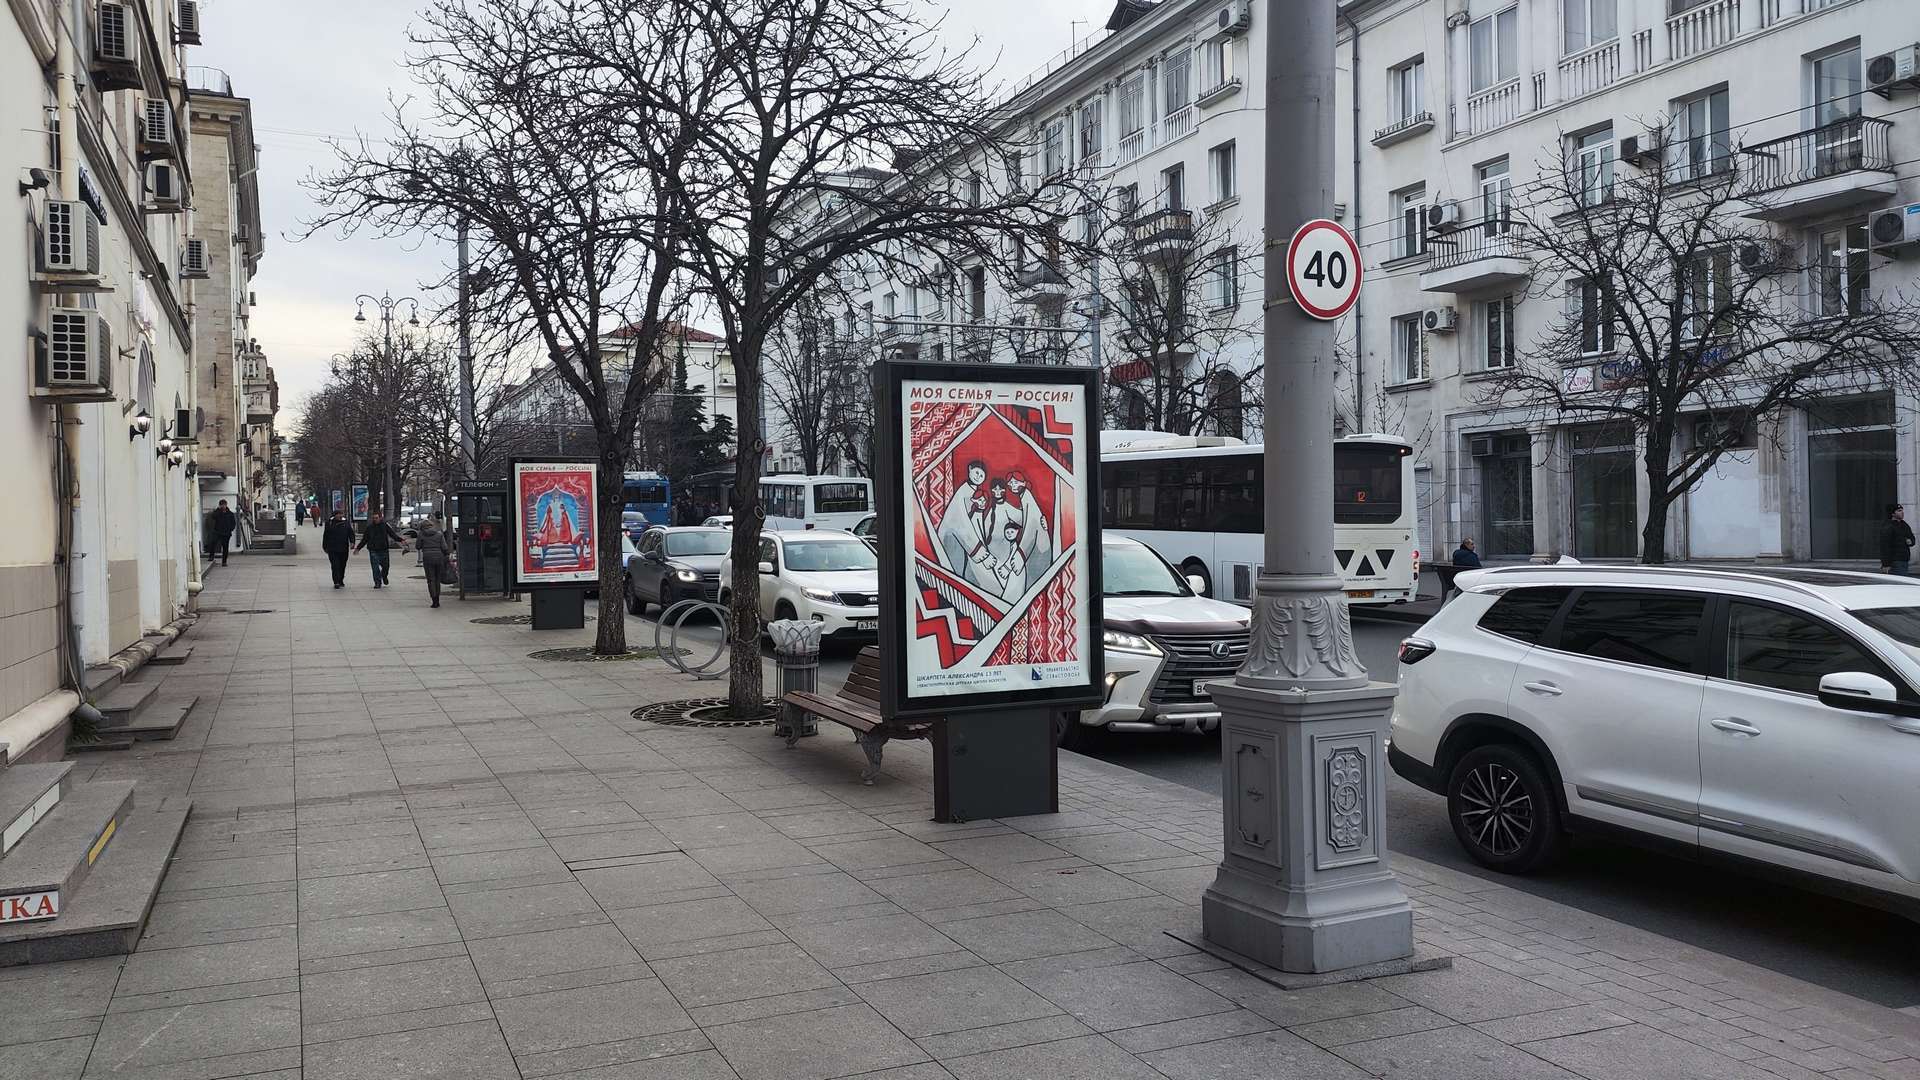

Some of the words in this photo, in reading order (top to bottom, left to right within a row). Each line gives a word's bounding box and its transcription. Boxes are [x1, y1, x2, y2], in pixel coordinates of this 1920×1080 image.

[1303, 250, 1347, 289] 40
[910, 387, 943, 399] МОЯ
[948, 388, 993, 400] СЕМЬЯ
[1015, 390, 1074, 402] РОССИЯ!
